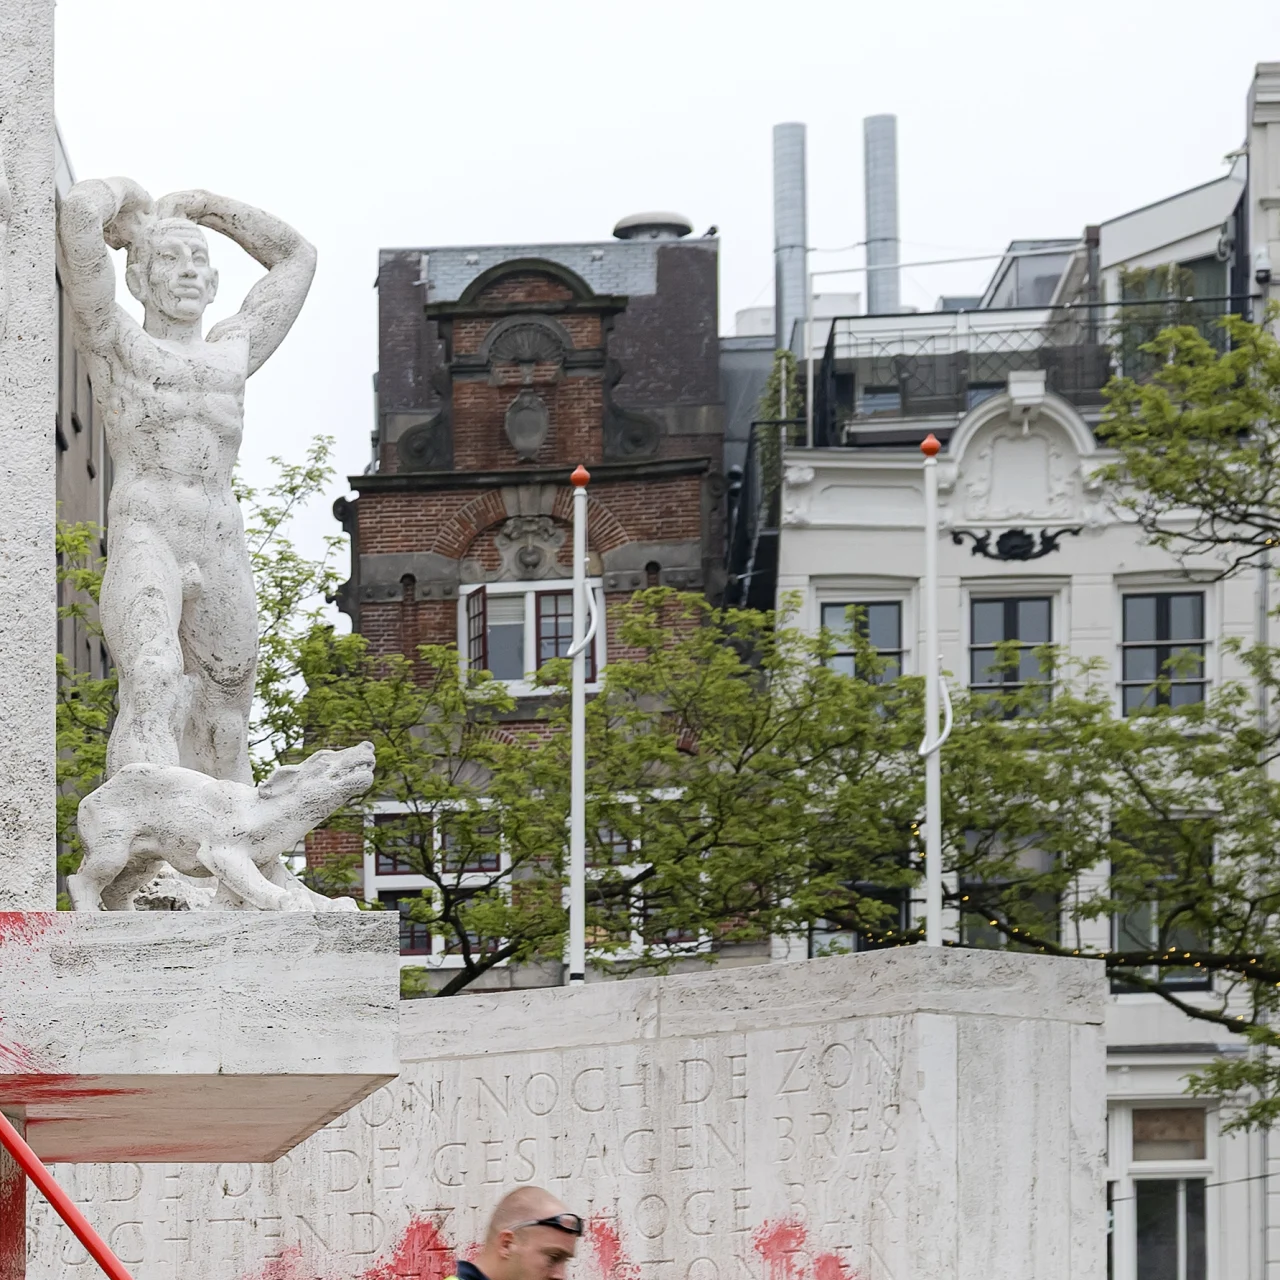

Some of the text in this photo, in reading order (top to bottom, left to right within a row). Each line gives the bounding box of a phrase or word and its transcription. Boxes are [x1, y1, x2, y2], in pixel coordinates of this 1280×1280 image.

[474, 1059, 650, 1118] NOCH
[678, 1051, 750, 1105] DE
[773, 1038, 903, 1098] ZON
[322, 1146, 404, 1195] DE
[432, 1117, 746, 1188] GESLAGEN
[771, 1102, 902, 1164] BRES
[583, 1186, 754, 1246] HOGE
